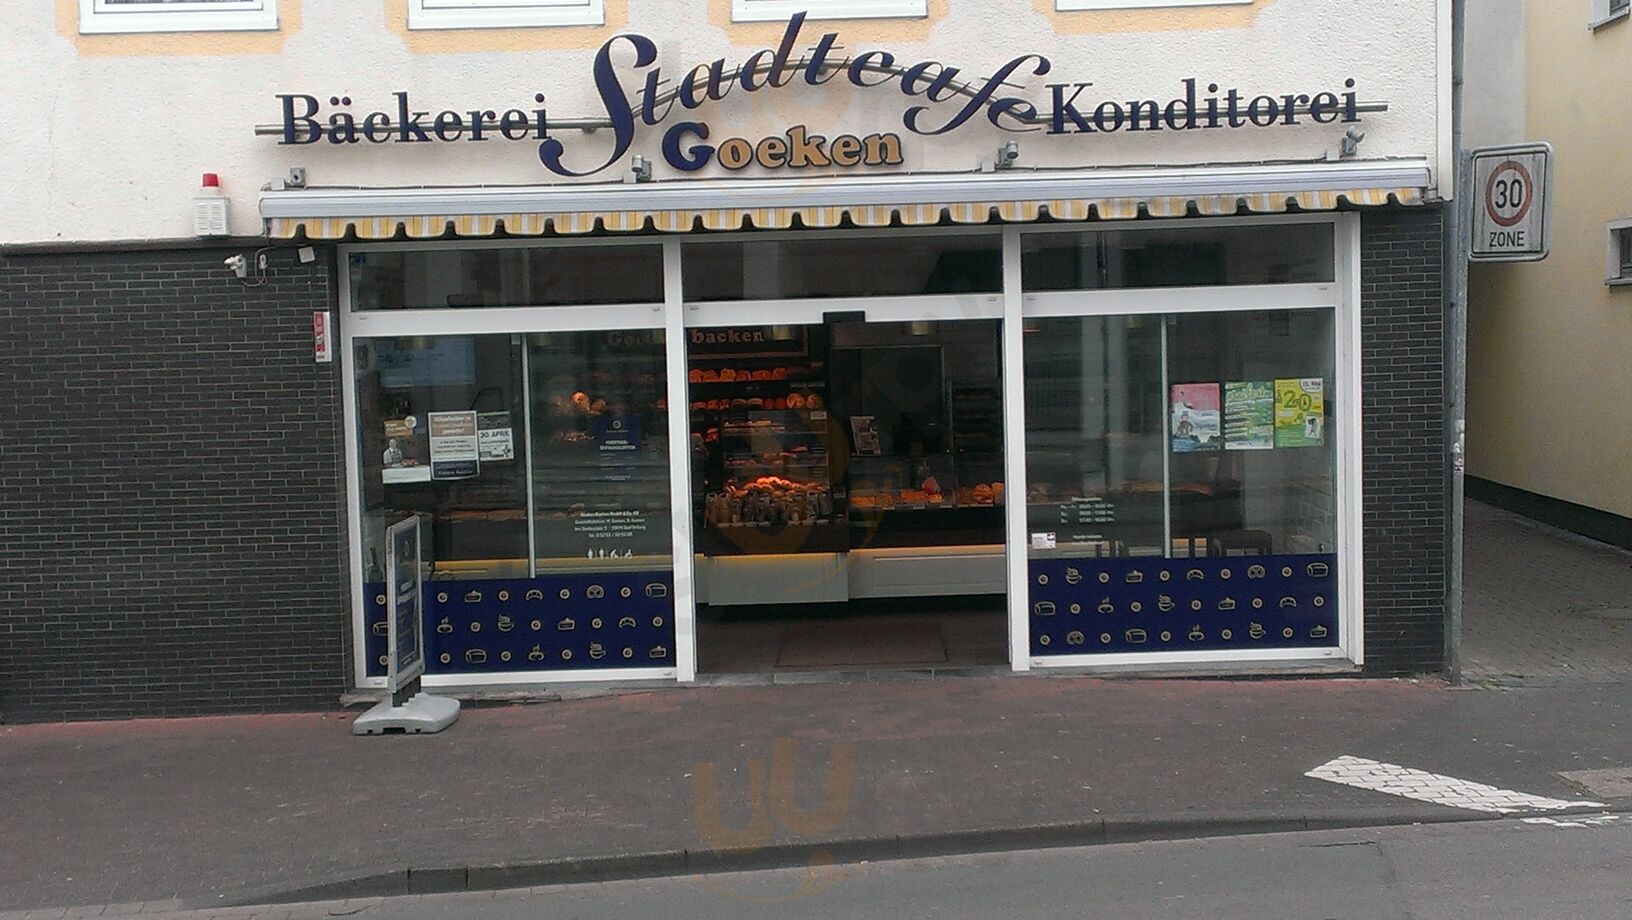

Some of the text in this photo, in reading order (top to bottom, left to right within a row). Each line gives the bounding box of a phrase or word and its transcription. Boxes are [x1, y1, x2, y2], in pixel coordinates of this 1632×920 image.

[275, 91, 552, 145] Bäckerei
[539, 11, 1051, 177] Stadtcafe
[1045, 78, 1362, 136] Konditorei
[661, 122, 904, 172] Goeken
[1495, 178, 1522, 209] 30
[1489, 231, 1525, 247] ZONE
[691, 328, 765, 345] backen
